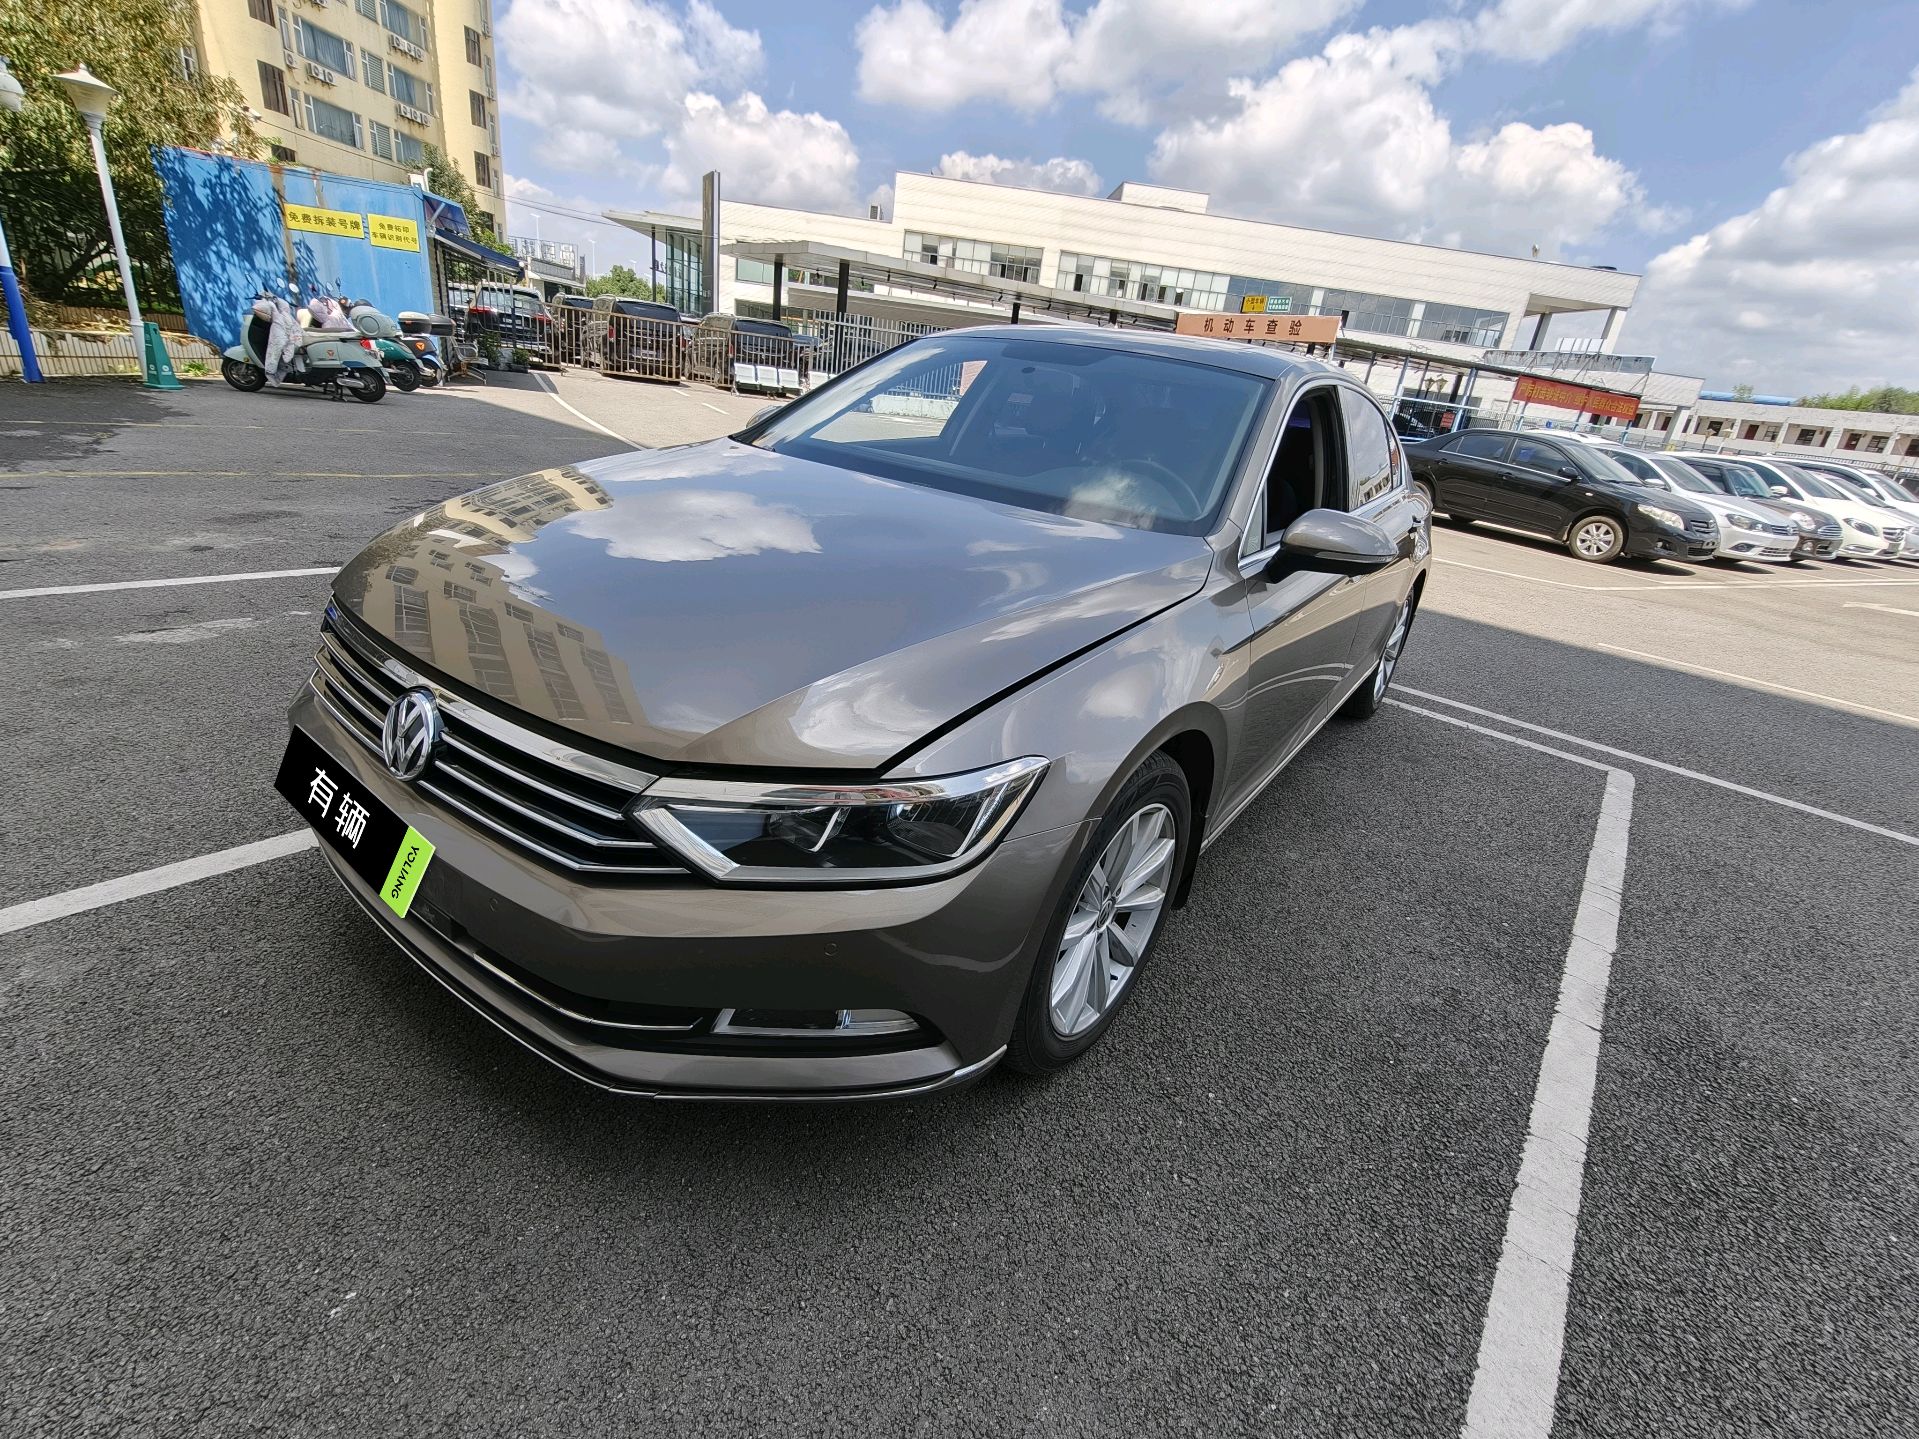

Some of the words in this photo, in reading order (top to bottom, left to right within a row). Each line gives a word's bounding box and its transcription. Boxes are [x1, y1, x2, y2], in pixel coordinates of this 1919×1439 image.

[288, 211, 361, 231] 免费拆装号牌
[378, 222, 410, 233] 免费拓印
[371, 231, 418, 244] 车辆识别代号
[1203, 317, 1303, 336] 机动车查验
